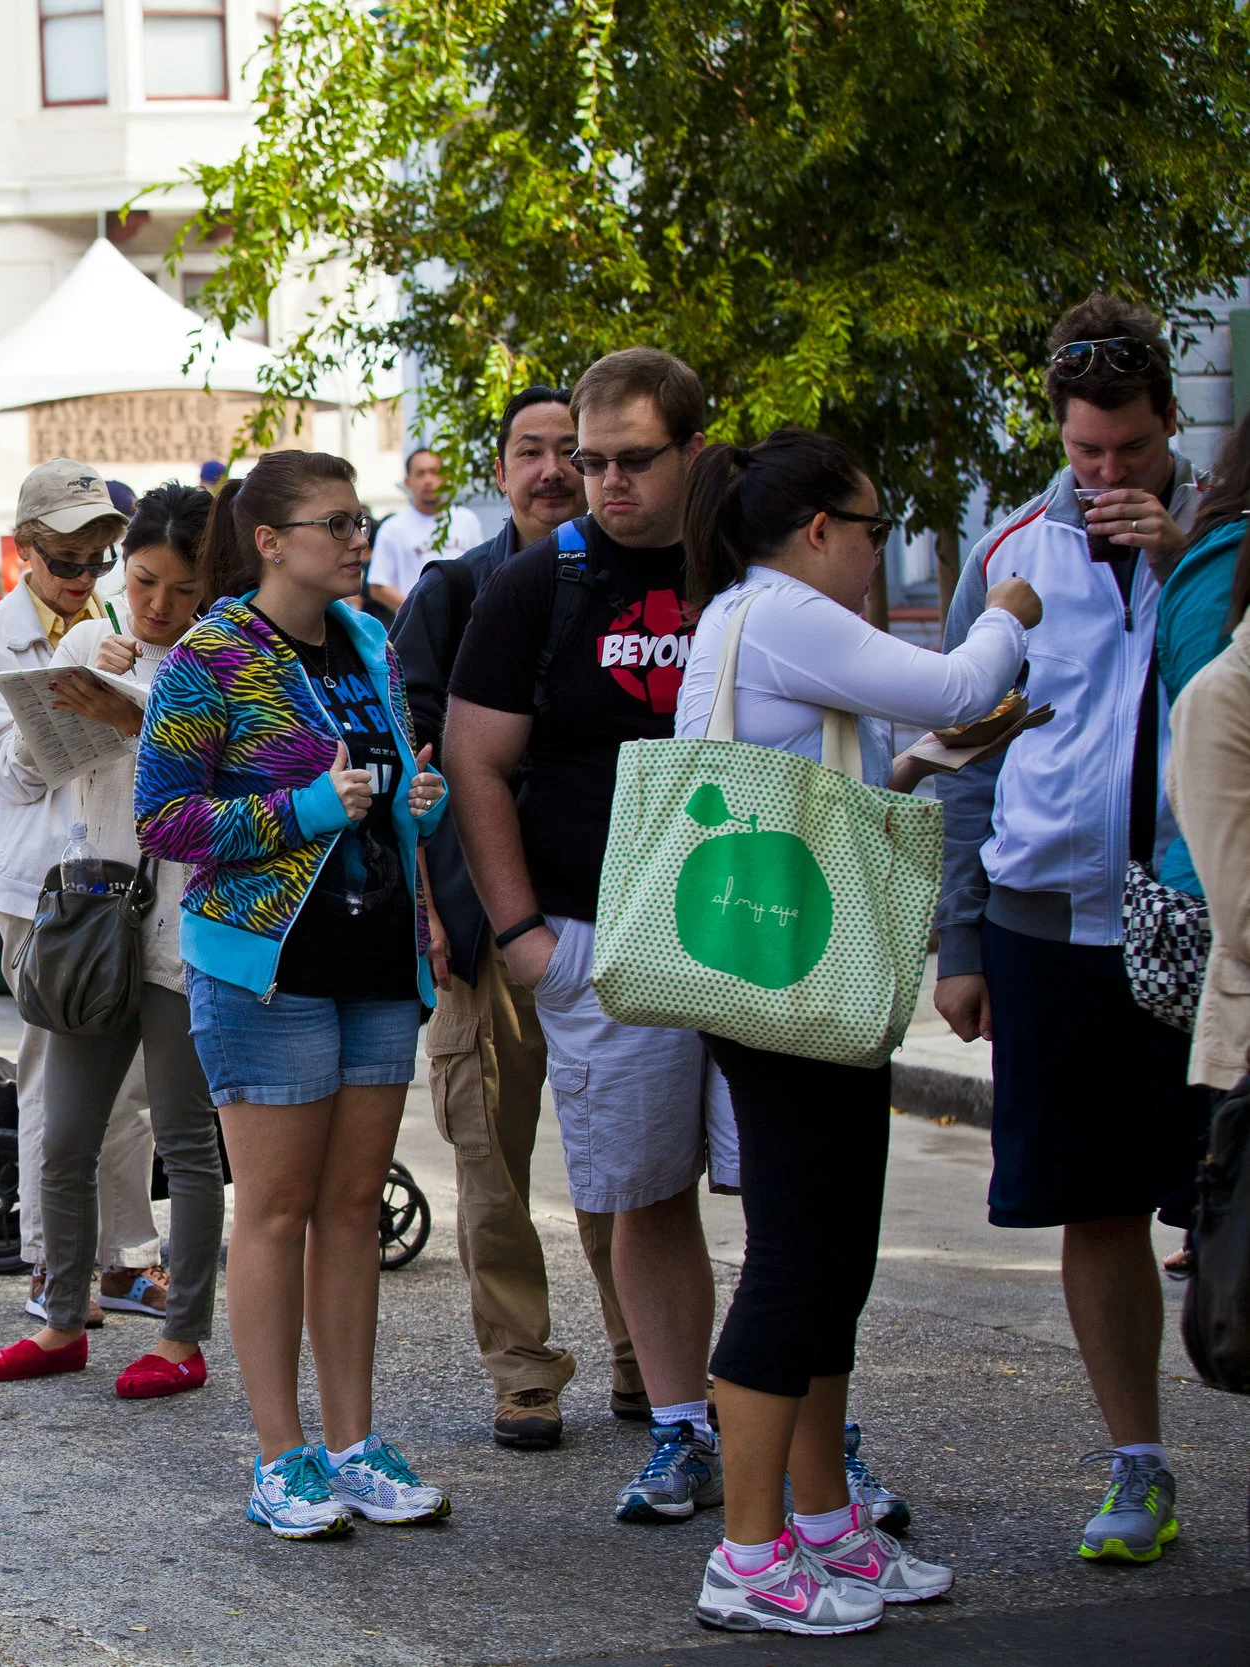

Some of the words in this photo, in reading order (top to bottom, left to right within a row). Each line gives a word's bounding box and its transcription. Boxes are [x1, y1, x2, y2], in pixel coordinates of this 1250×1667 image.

[710, 876, 734, 915] of
[734, 898, 766, 922] my
[769, 904, 799, 926] eye
